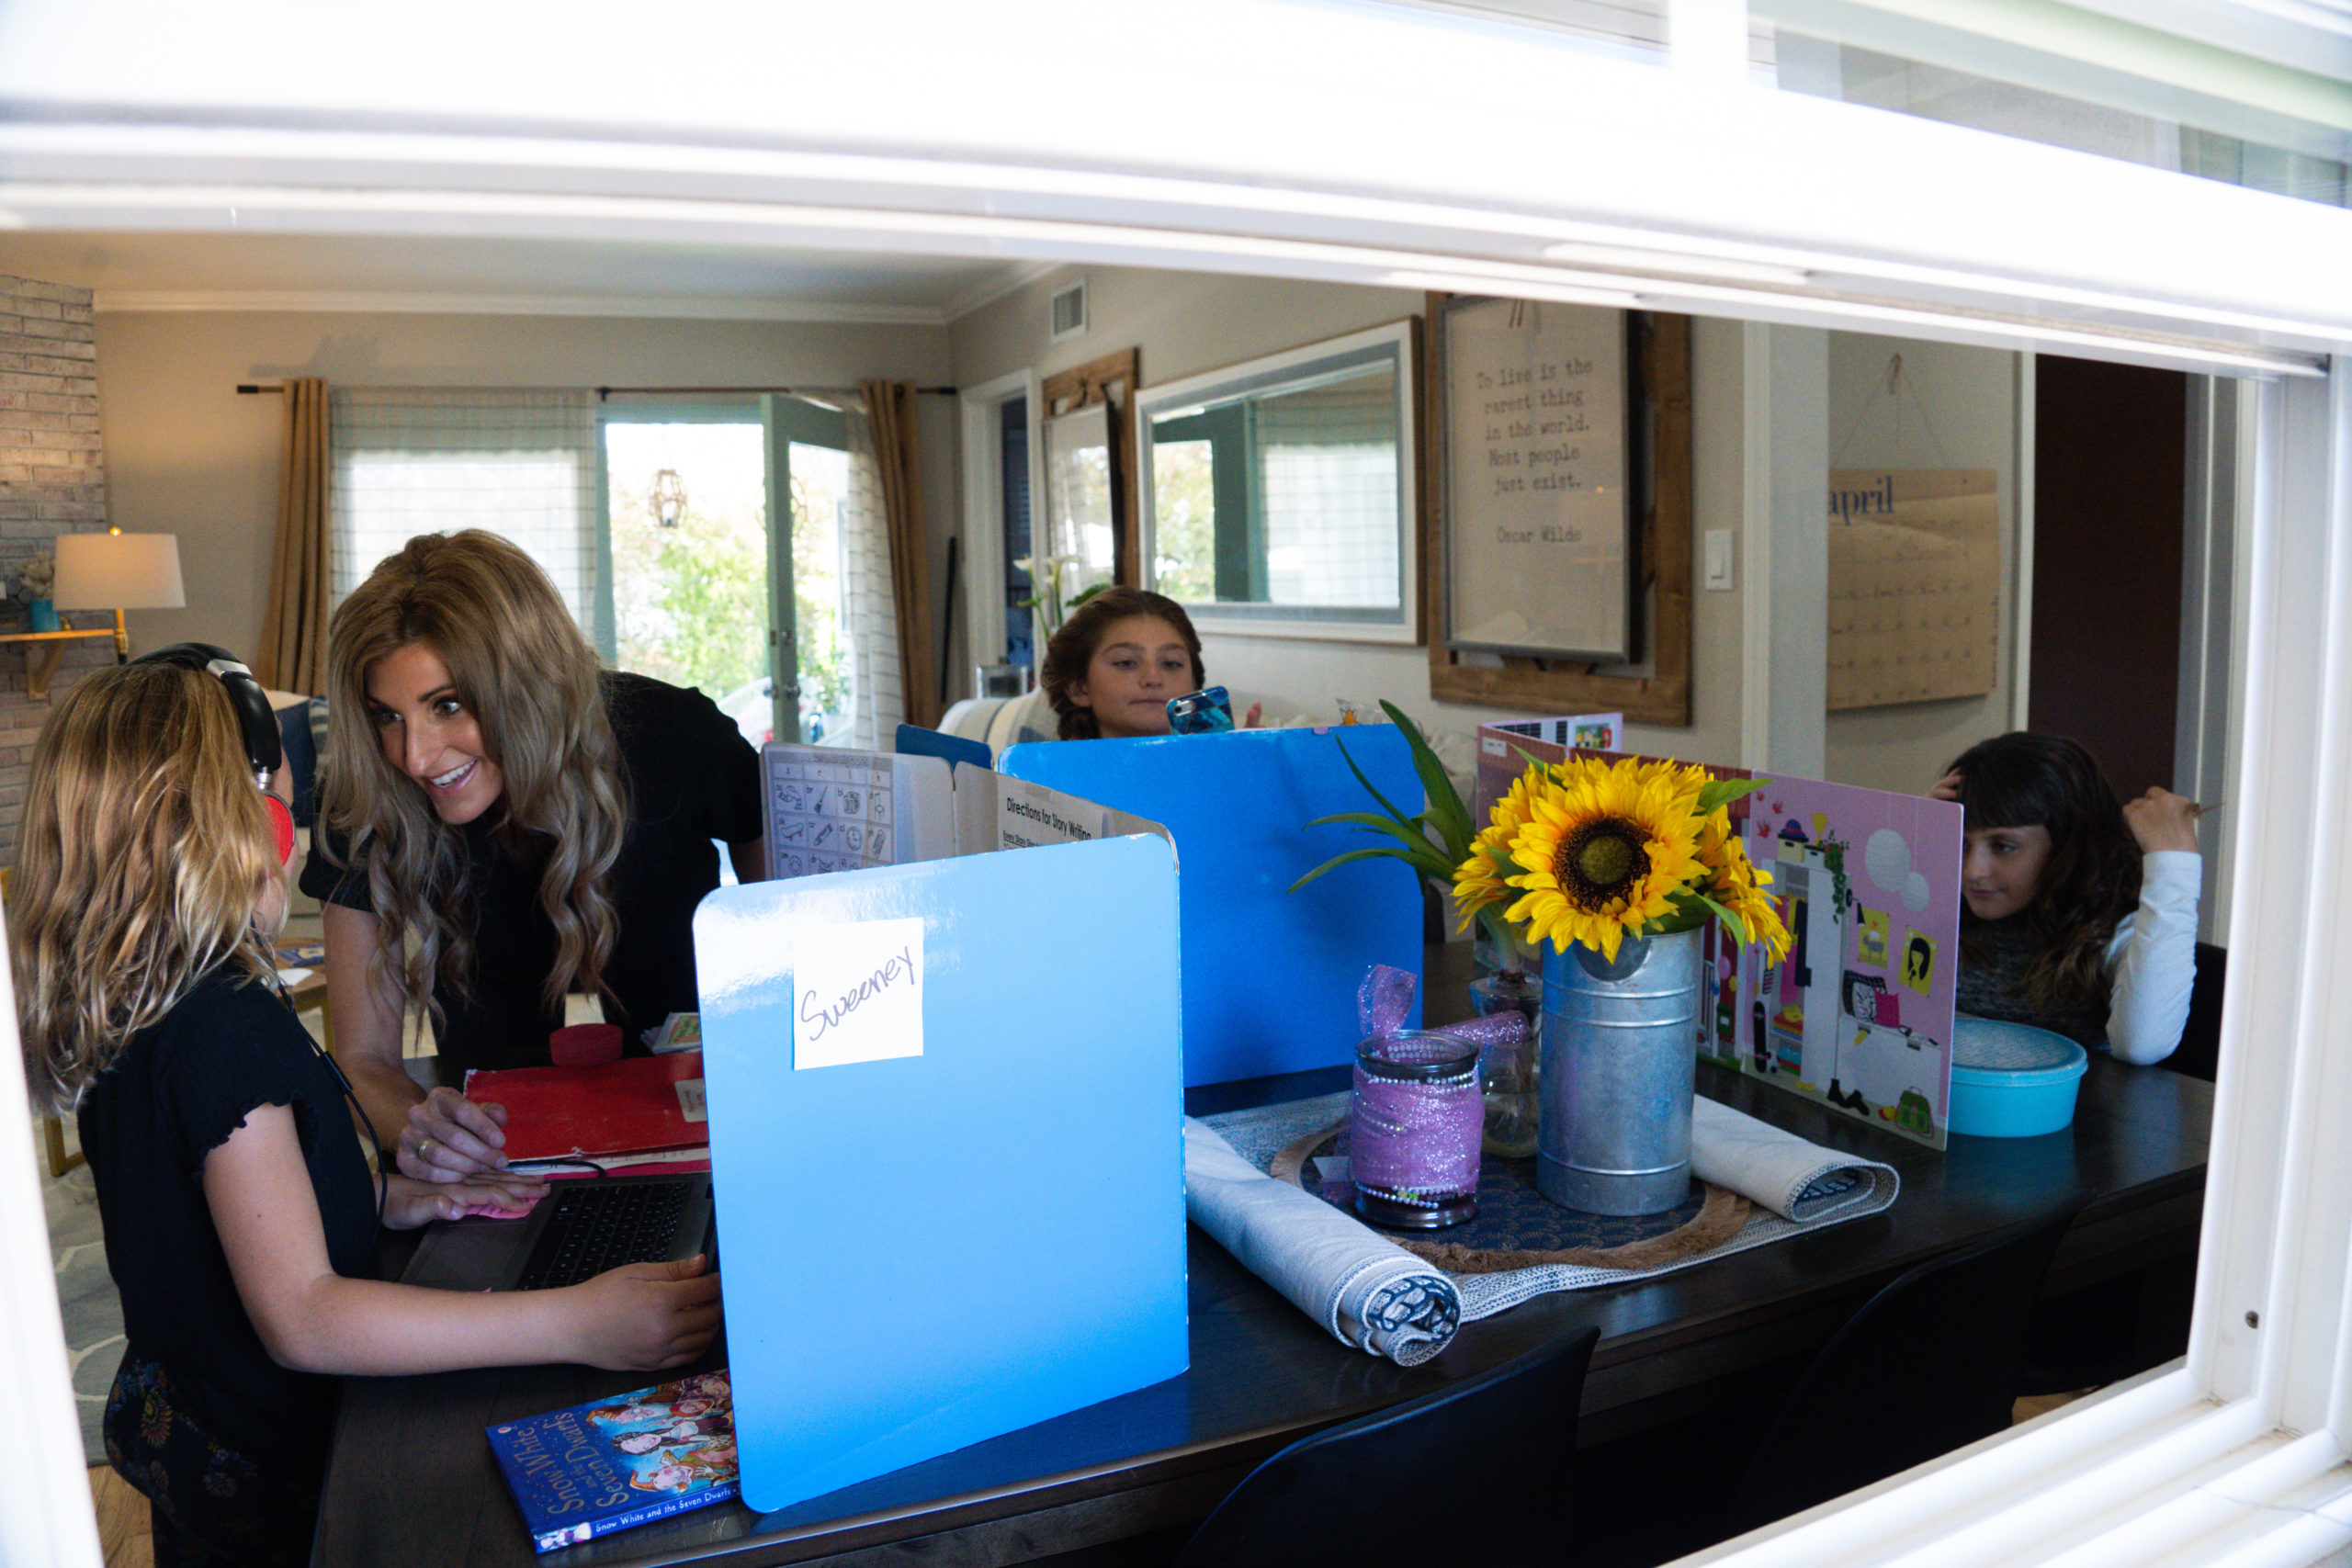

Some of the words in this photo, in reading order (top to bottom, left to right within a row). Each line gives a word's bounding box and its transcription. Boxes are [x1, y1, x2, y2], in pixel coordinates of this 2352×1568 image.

[1476, 371, 1492, 389] To
[1500, 368, 1532, 386] live
[1541, 364, 1556, 380] is
[1566, 357, 1592, 376] the
[1484, 394, 1532, 414] rarest
[1541, 389, 1583, 408] thing
[1486, 424, 1501, 441] in
[1510, 421, 1532, 437] the
[1489, 448, 1520, 466] Most
[1529, 443, 1580, 468] people
[1494, 476, 1522, 496] just
[1497, 525, 1532, 543] Oscar
[1541, 525, 1581, 542] Wilde
[1007, 797, 1041, 822] Directions
[1042, 808, 1052, 826] for
[1053, 813, 1068, 836] Story
[800, 945, 915, 1042] Sweeney
[514, 1427, 556, 1476] White
[543, 1412, 600, 1463] Dwarfs
[548, 1469, 585, 1514] Snow
[588, 1459, 630, 1507] Seven
[595, 1521, 617, 1532] Snow
[619, 1511, 644, 1525] White
[647, 1506, 662, 1518] and
[664, 1504, 677, 1513] the
[679, 1495, 703, 1509] Seven
[704, 1487, 732, 1503] Dwarfs
